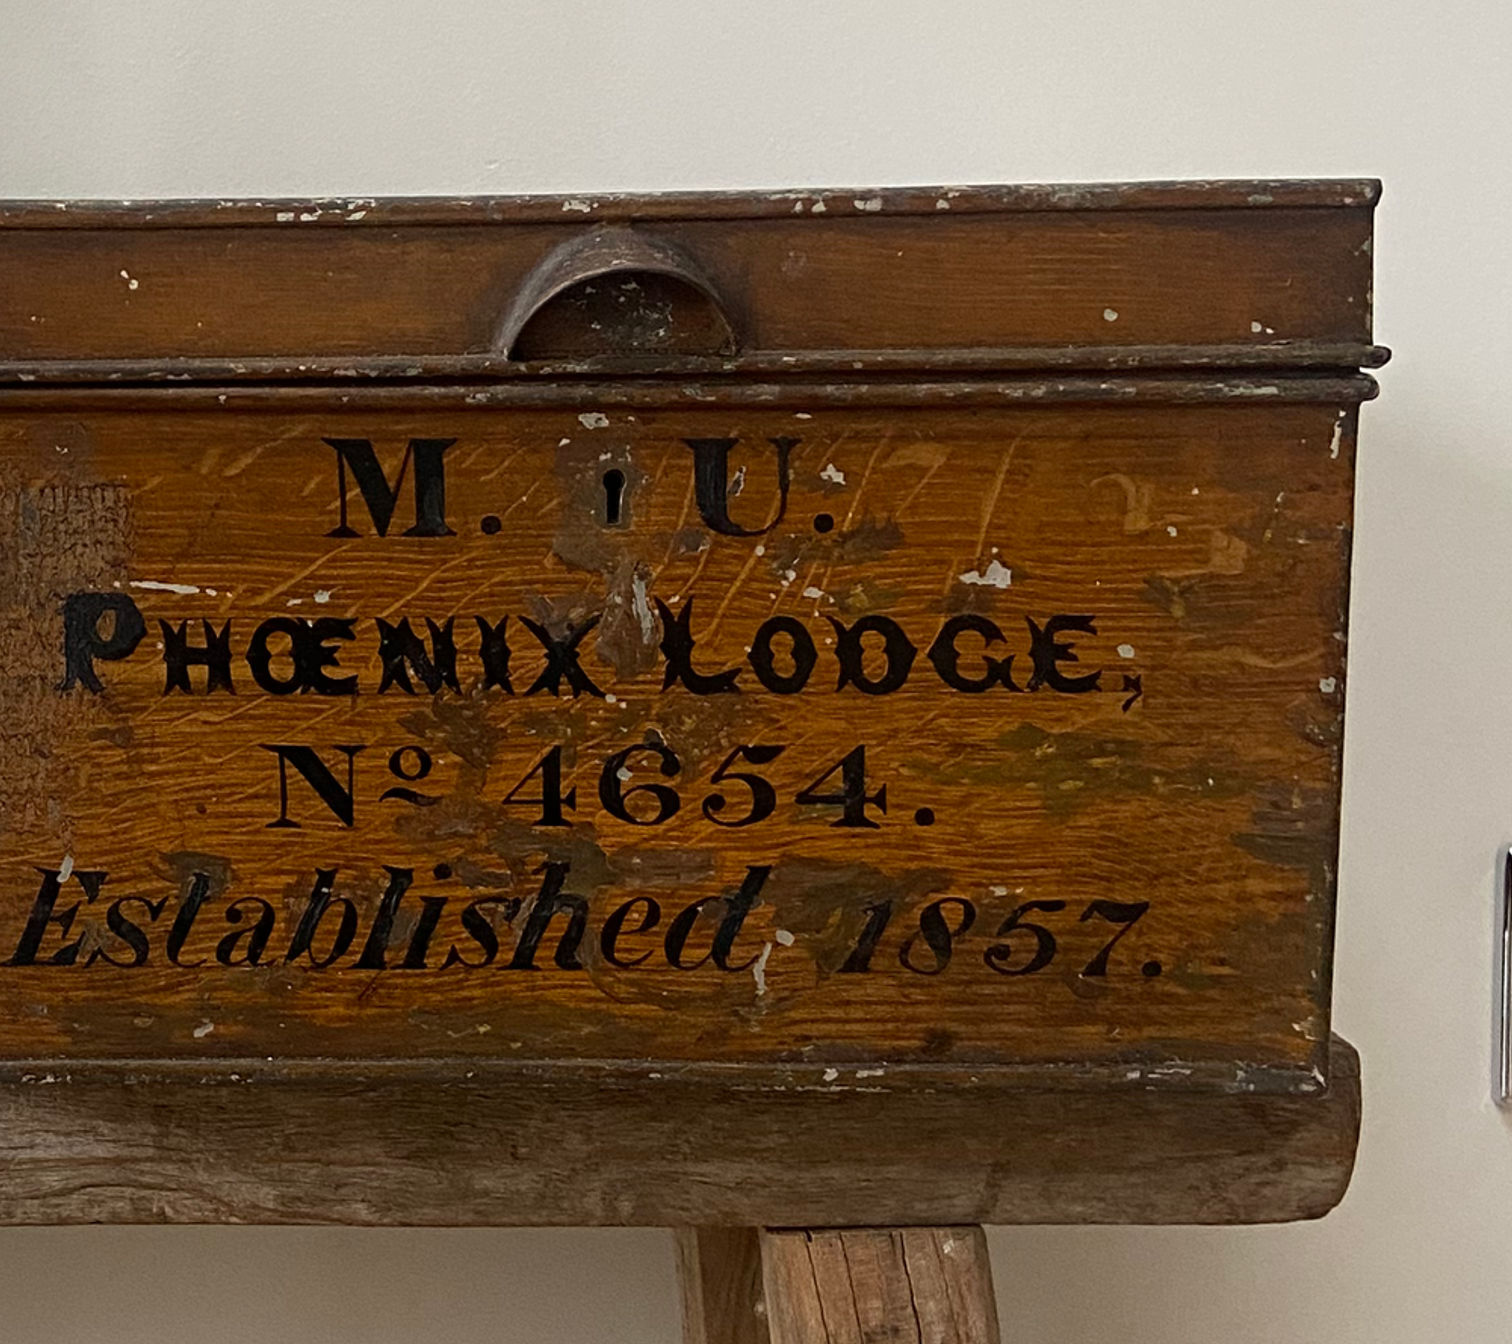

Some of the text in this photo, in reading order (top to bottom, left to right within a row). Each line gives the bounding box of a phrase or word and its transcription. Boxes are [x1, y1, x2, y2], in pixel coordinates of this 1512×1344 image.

[321, 437, 835, 538] M. U.
[655, 593, 1143, 712] LODGE,
[502, 744, 936, 829] 4654.
[832, 896, 1163, 978] 1857.
